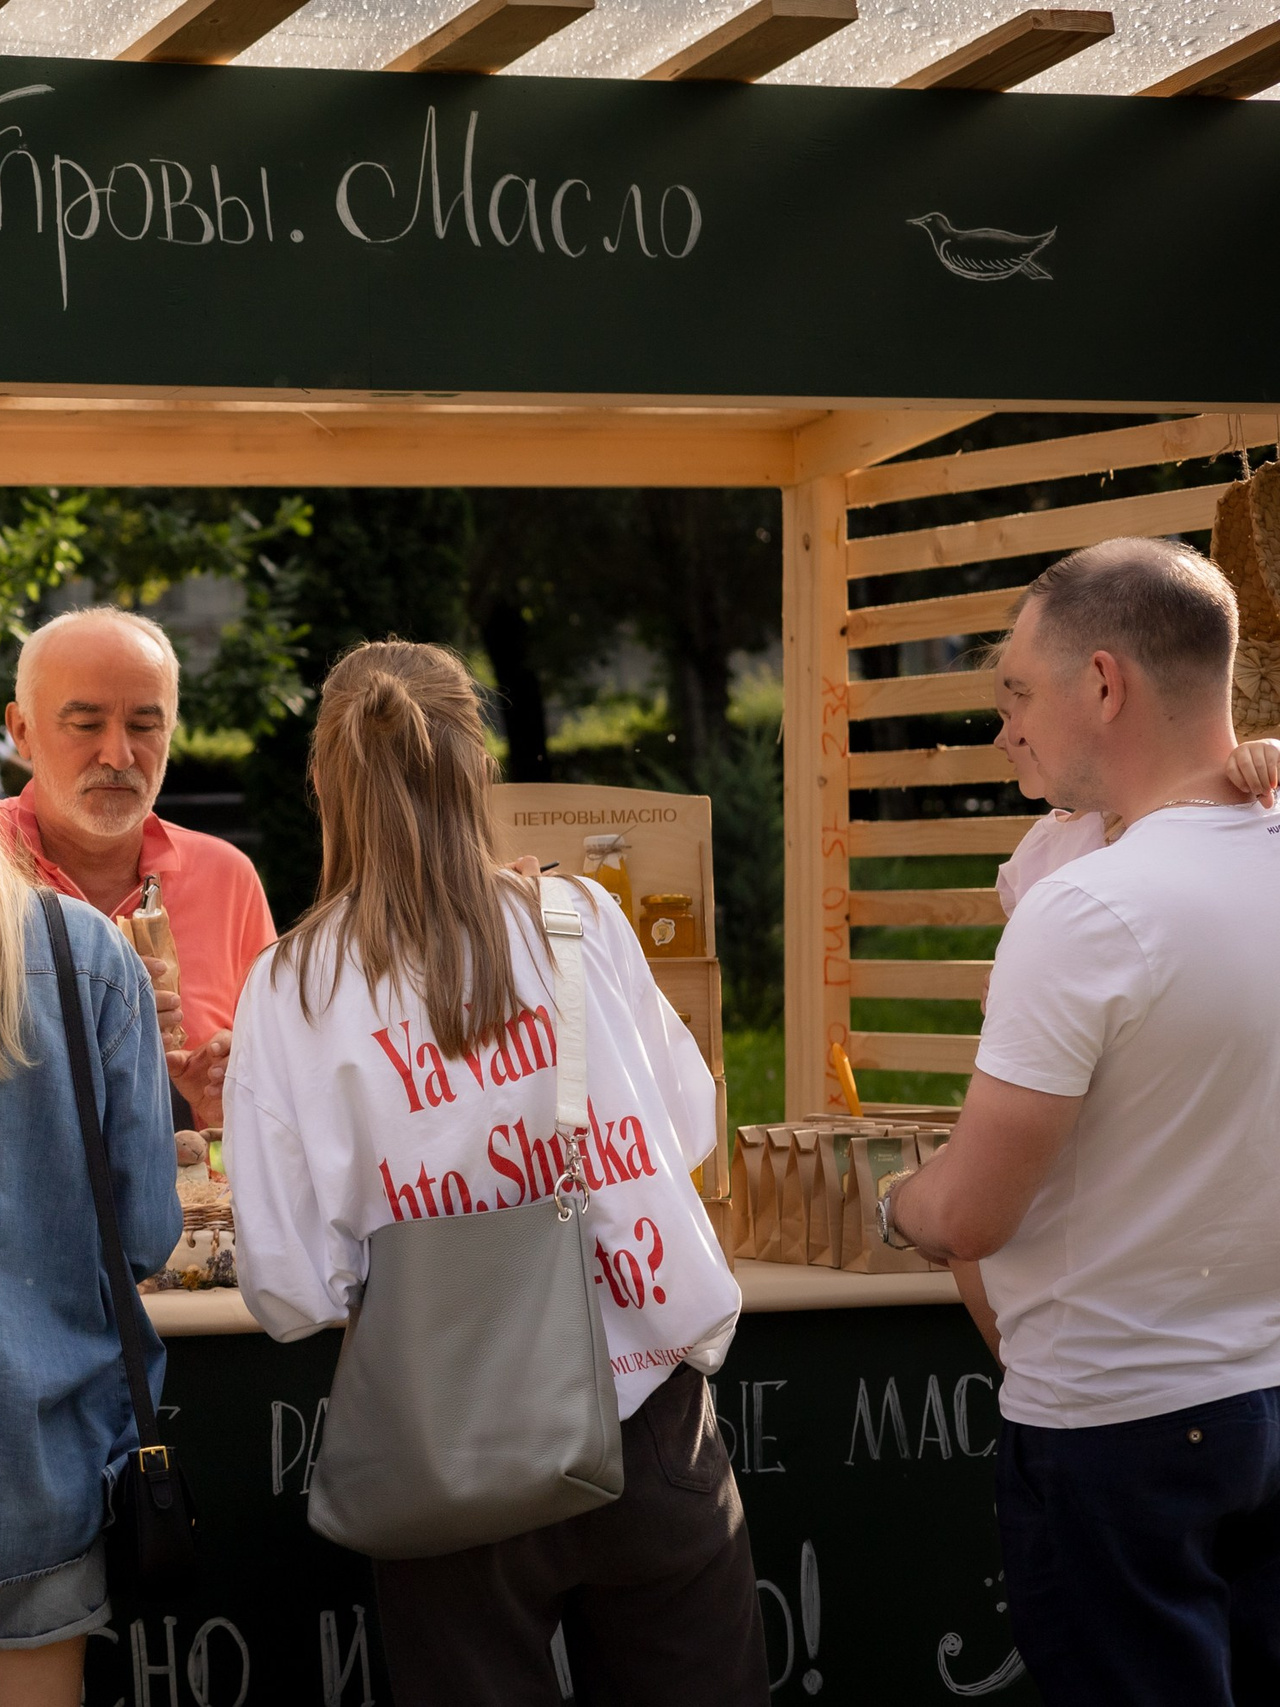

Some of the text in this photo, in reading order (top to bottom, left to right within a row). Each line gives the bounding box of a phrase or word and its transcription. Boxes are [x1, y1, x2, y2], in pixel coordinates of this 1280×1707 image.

[336, 105, 702, 259] Масло
[371, 1020, 457, 1113] Ya
[594, 1217, 667, 1310] -to?
[844, 1374, 999, 1465] МАС
